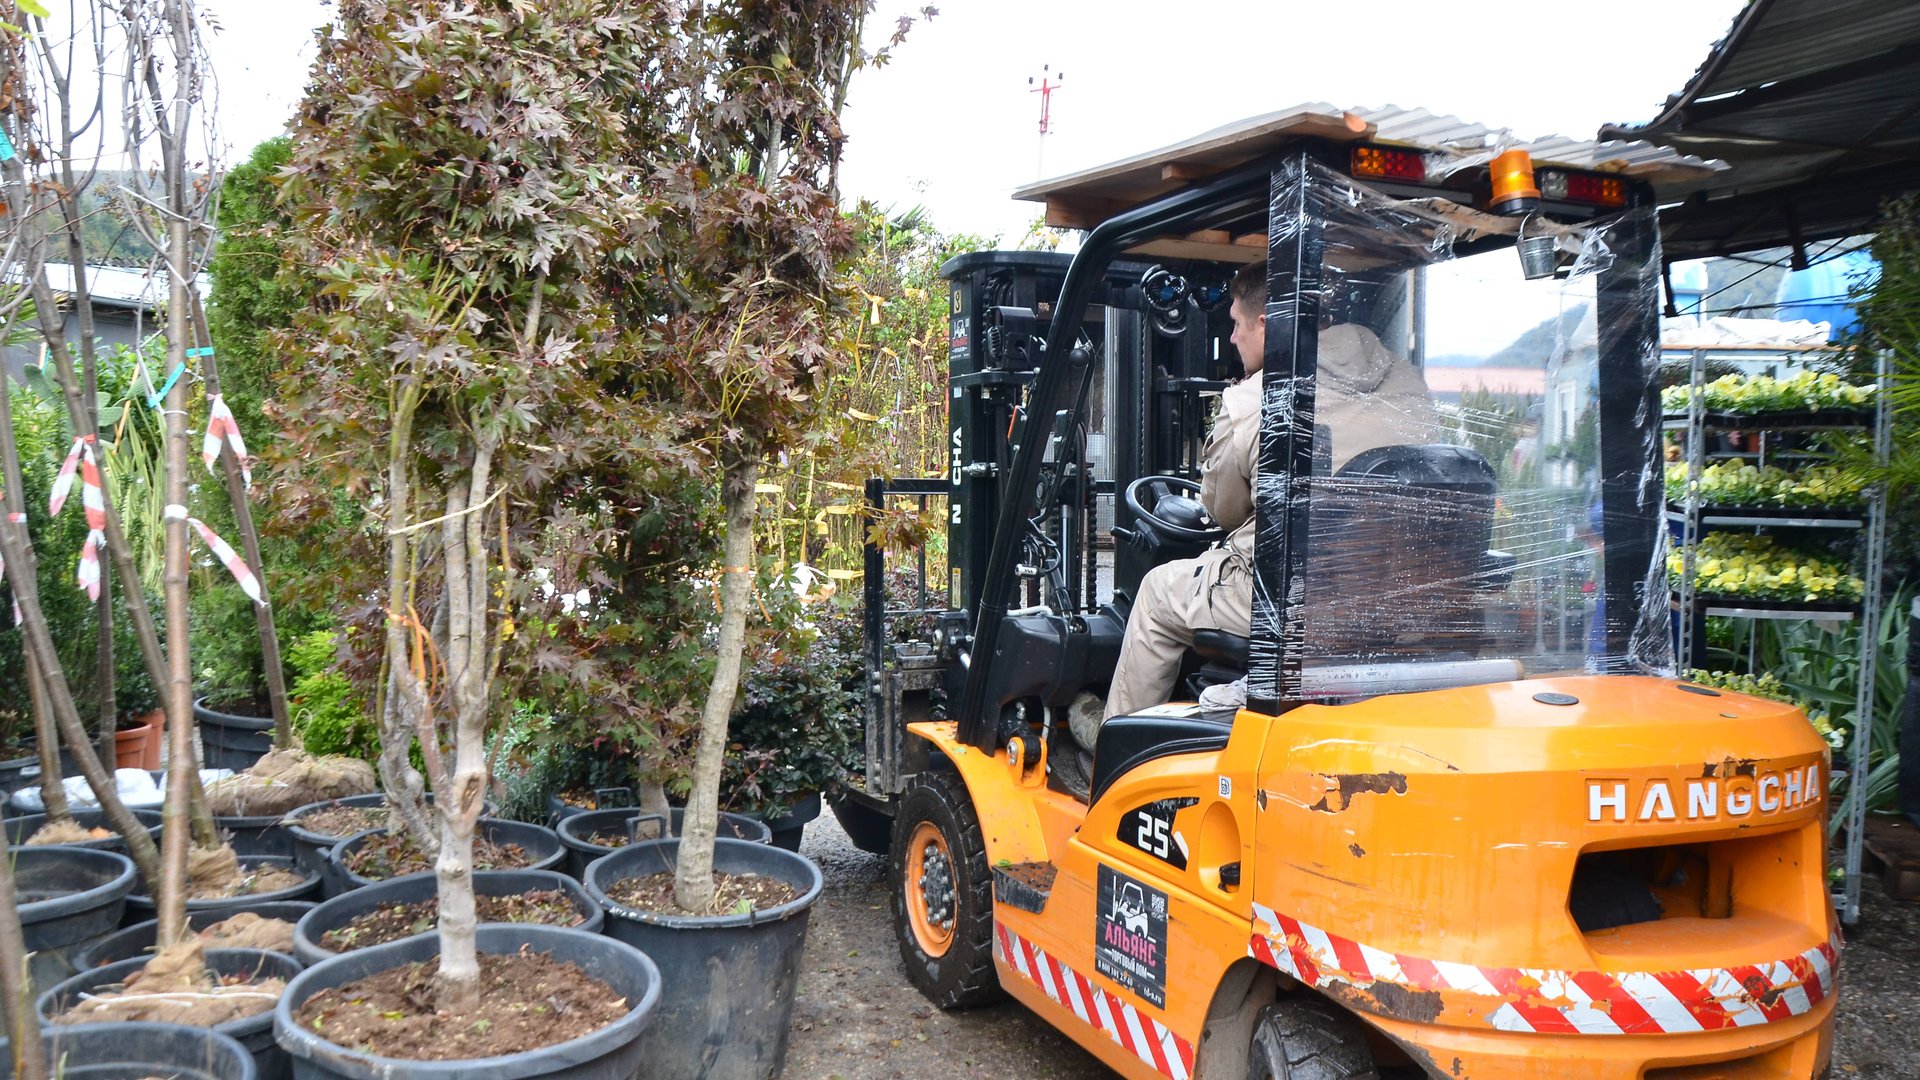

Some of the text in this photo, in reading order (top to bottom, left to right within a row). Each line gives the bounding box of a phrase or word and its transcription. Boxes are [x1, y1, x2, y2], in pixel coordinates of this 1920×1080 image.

[1589, 765, 1819, 821] HANGCHA
[1138, 811, 1169, 859] 25
[1105, 921, 1157, 968] АЛЬЯНС
